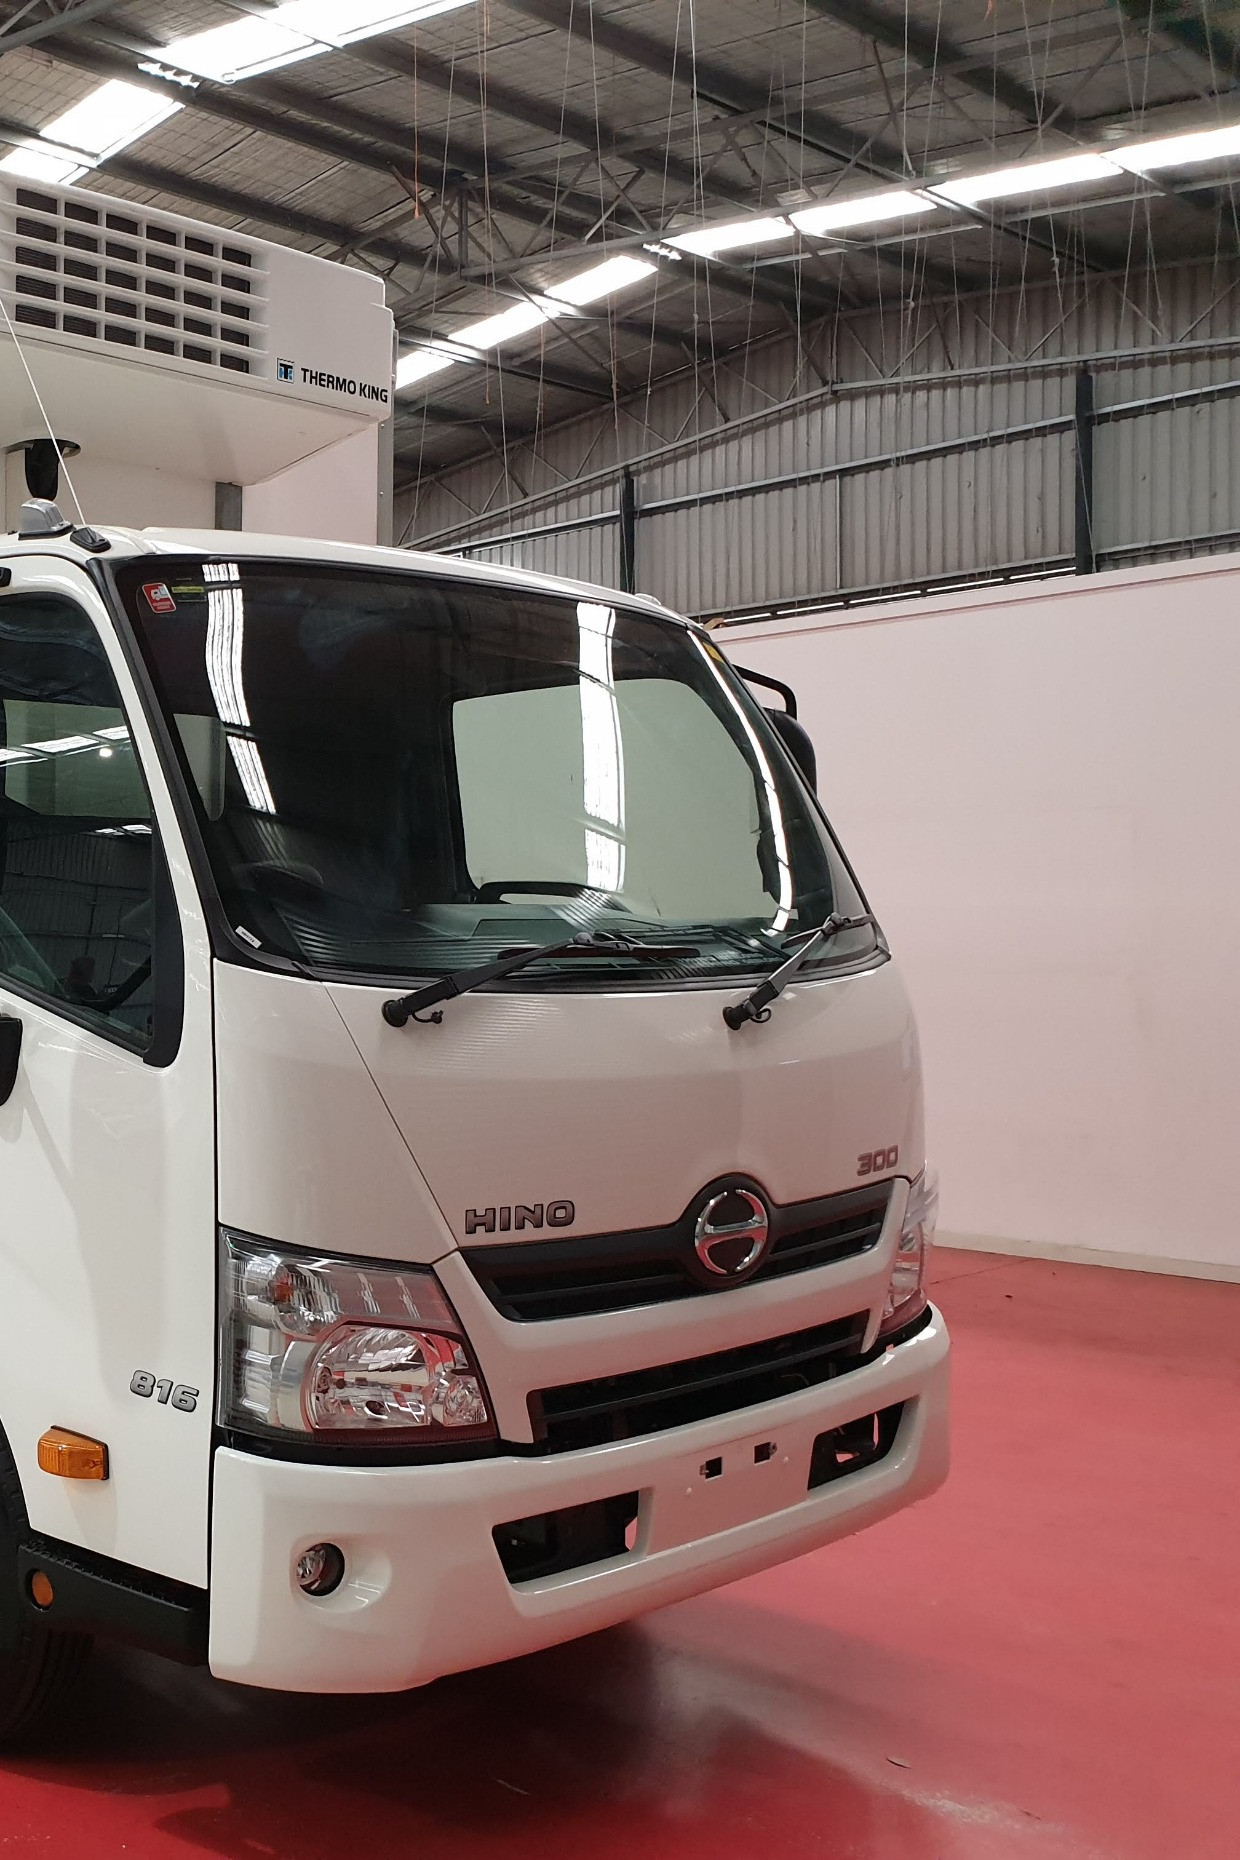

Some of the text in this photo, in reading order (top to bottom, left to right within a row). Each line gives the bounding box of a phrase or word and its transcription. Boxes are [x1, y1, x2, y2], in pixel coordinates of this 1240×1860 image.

[300, 367, 388, 403] THERMO KING
[856, 1145, 900, 1176] 300
[464, 1200, 575, 1235] HINO
[129, 1369, 200, 1413] 816
